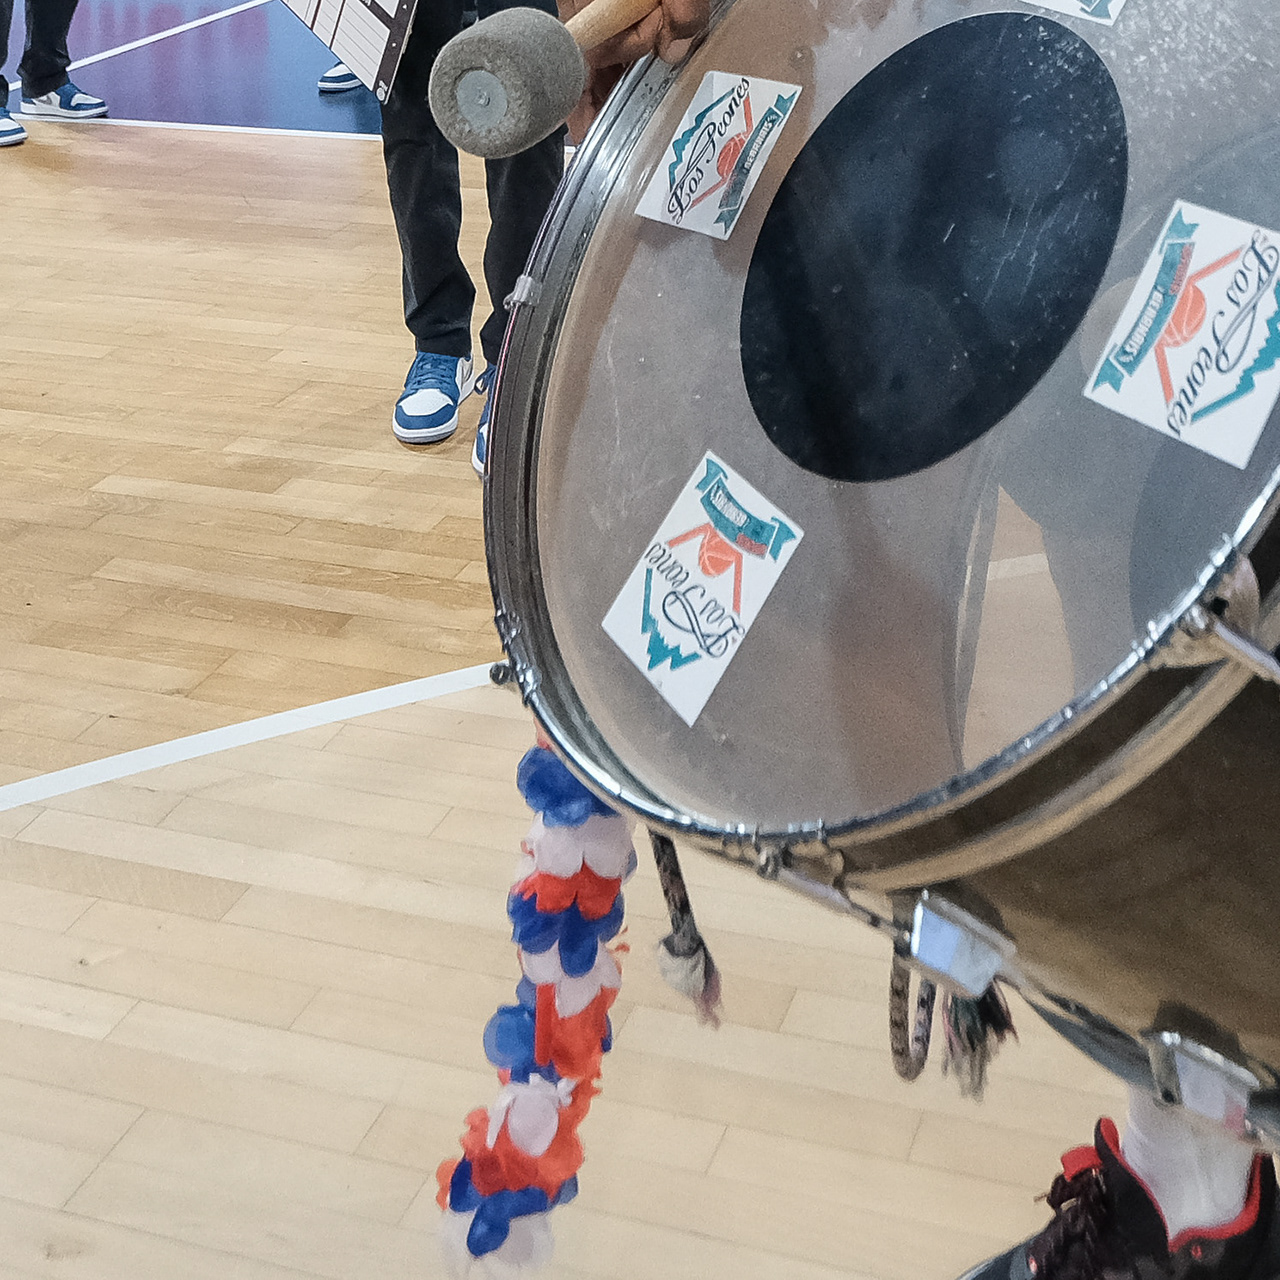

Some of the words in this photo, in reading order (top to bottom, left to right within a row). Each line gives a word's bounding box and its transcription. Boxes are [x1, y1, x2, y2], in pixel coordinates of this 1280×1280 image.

[667, 167, 705, 225] Los
[1225, 229, 1280, 306] Los
[700, 597, 746, 658] Los
